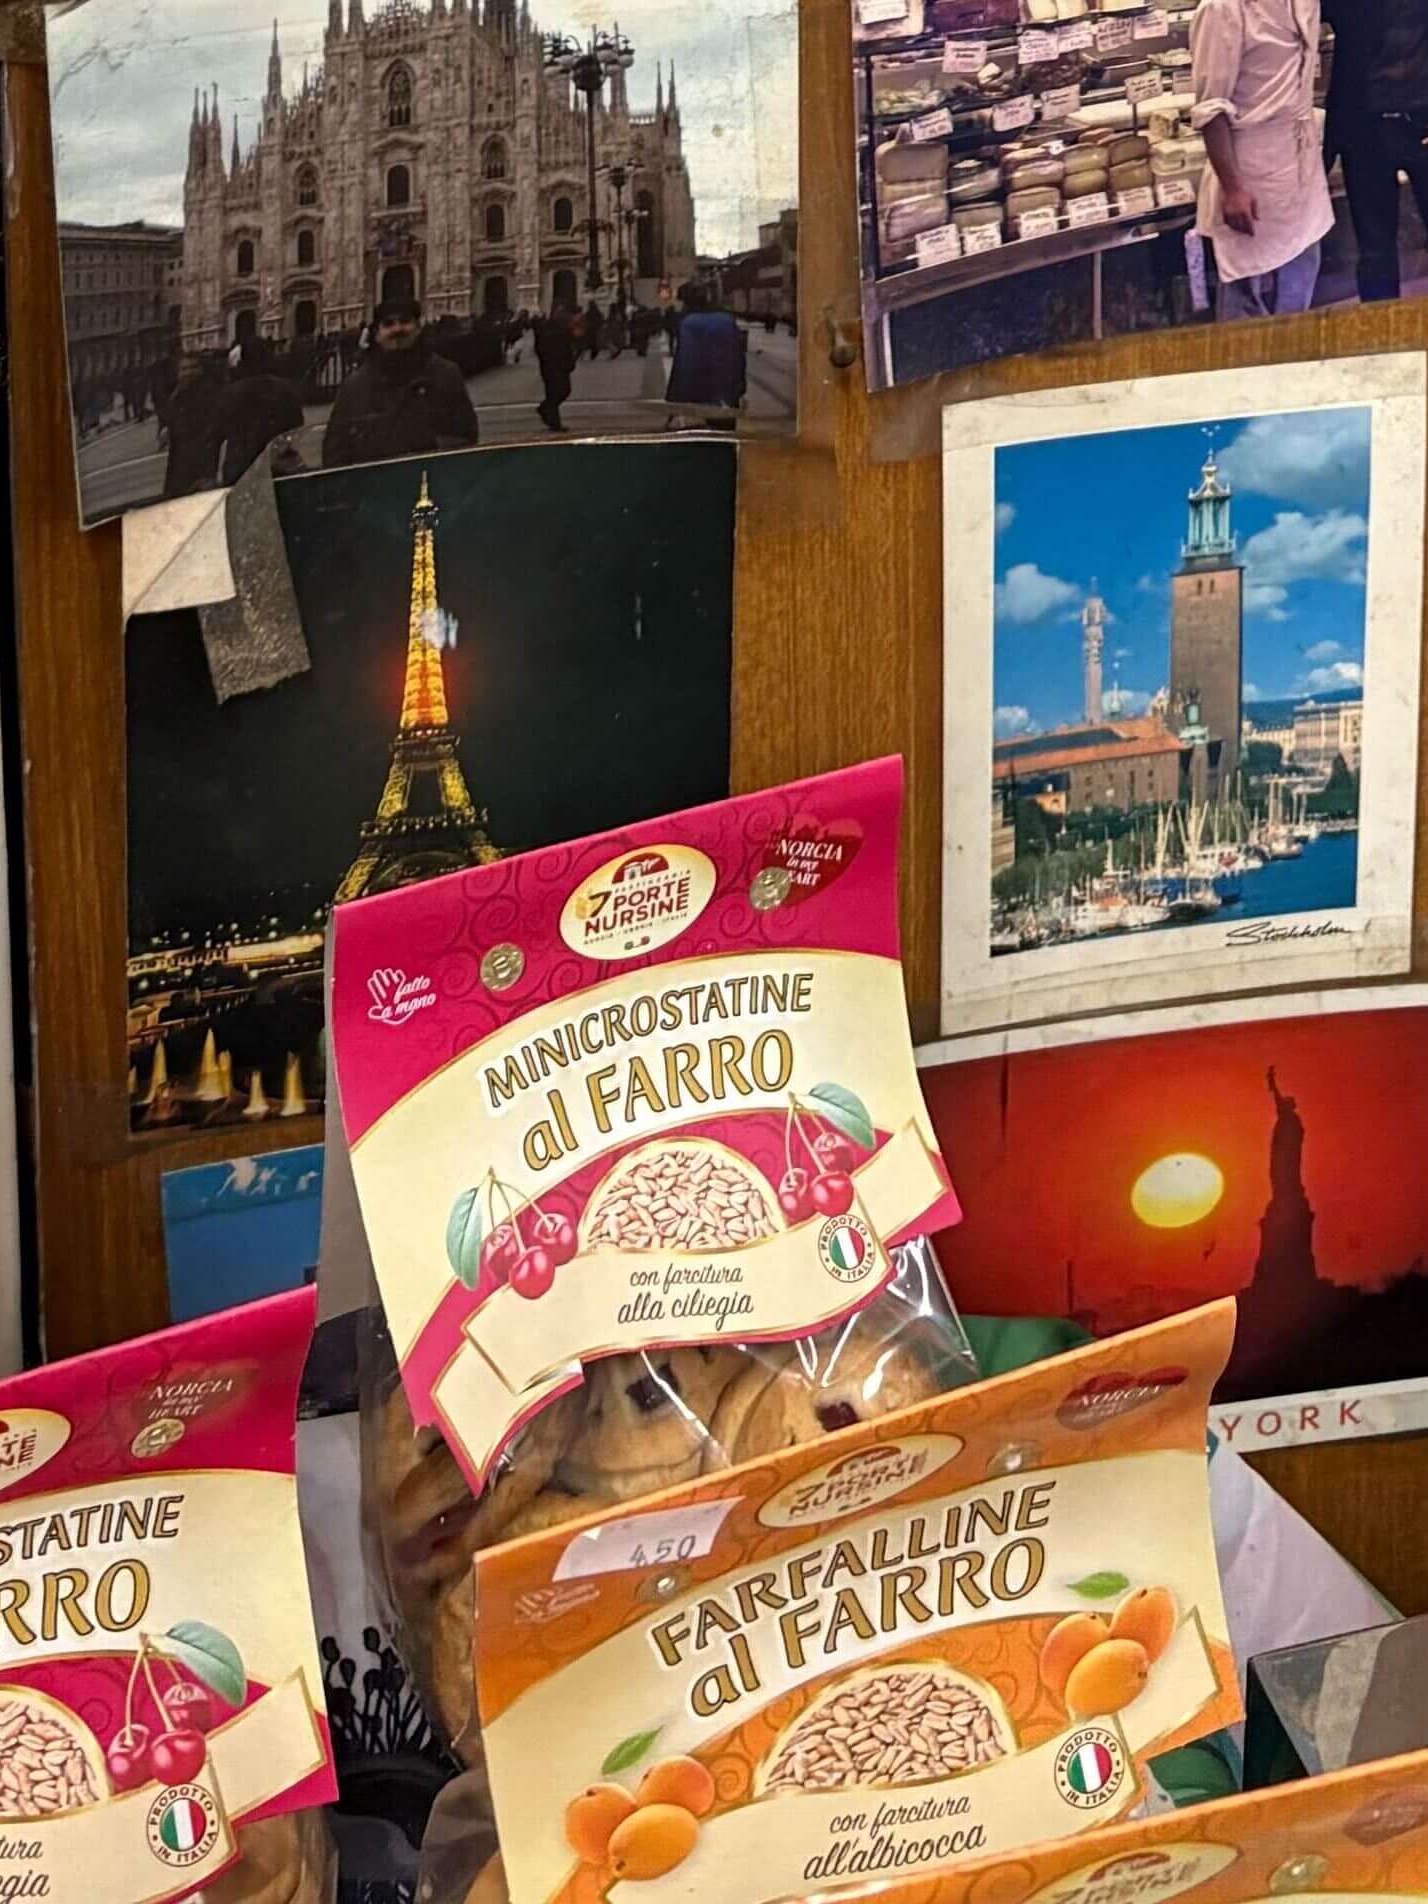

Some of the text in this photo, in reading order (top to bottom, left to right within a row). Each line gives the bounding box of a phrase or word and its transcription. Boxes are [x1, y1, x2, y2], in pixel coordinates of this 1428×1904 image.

[583, 895, 690, 937] NURSINE
[613, 878, 691, 914] PORTE
[486, 971, 813, 1108] MINICROSTATINE
[522, 1030, 794, 1172] al FARRO
[629, 1264, 743, 1292] con farcitura
[618, 1291, 753, 1329] alla ciliegia
[1220, 1397, 1364, 1441] YORK
[653, 1483, 1058, 1666] FARFALLINE
[691, 1537, 1045, 1720] al FARRO
[828, 1795, 970, 1834] con farcitura
[803, 1821, 986, 1881] all'albicocca
